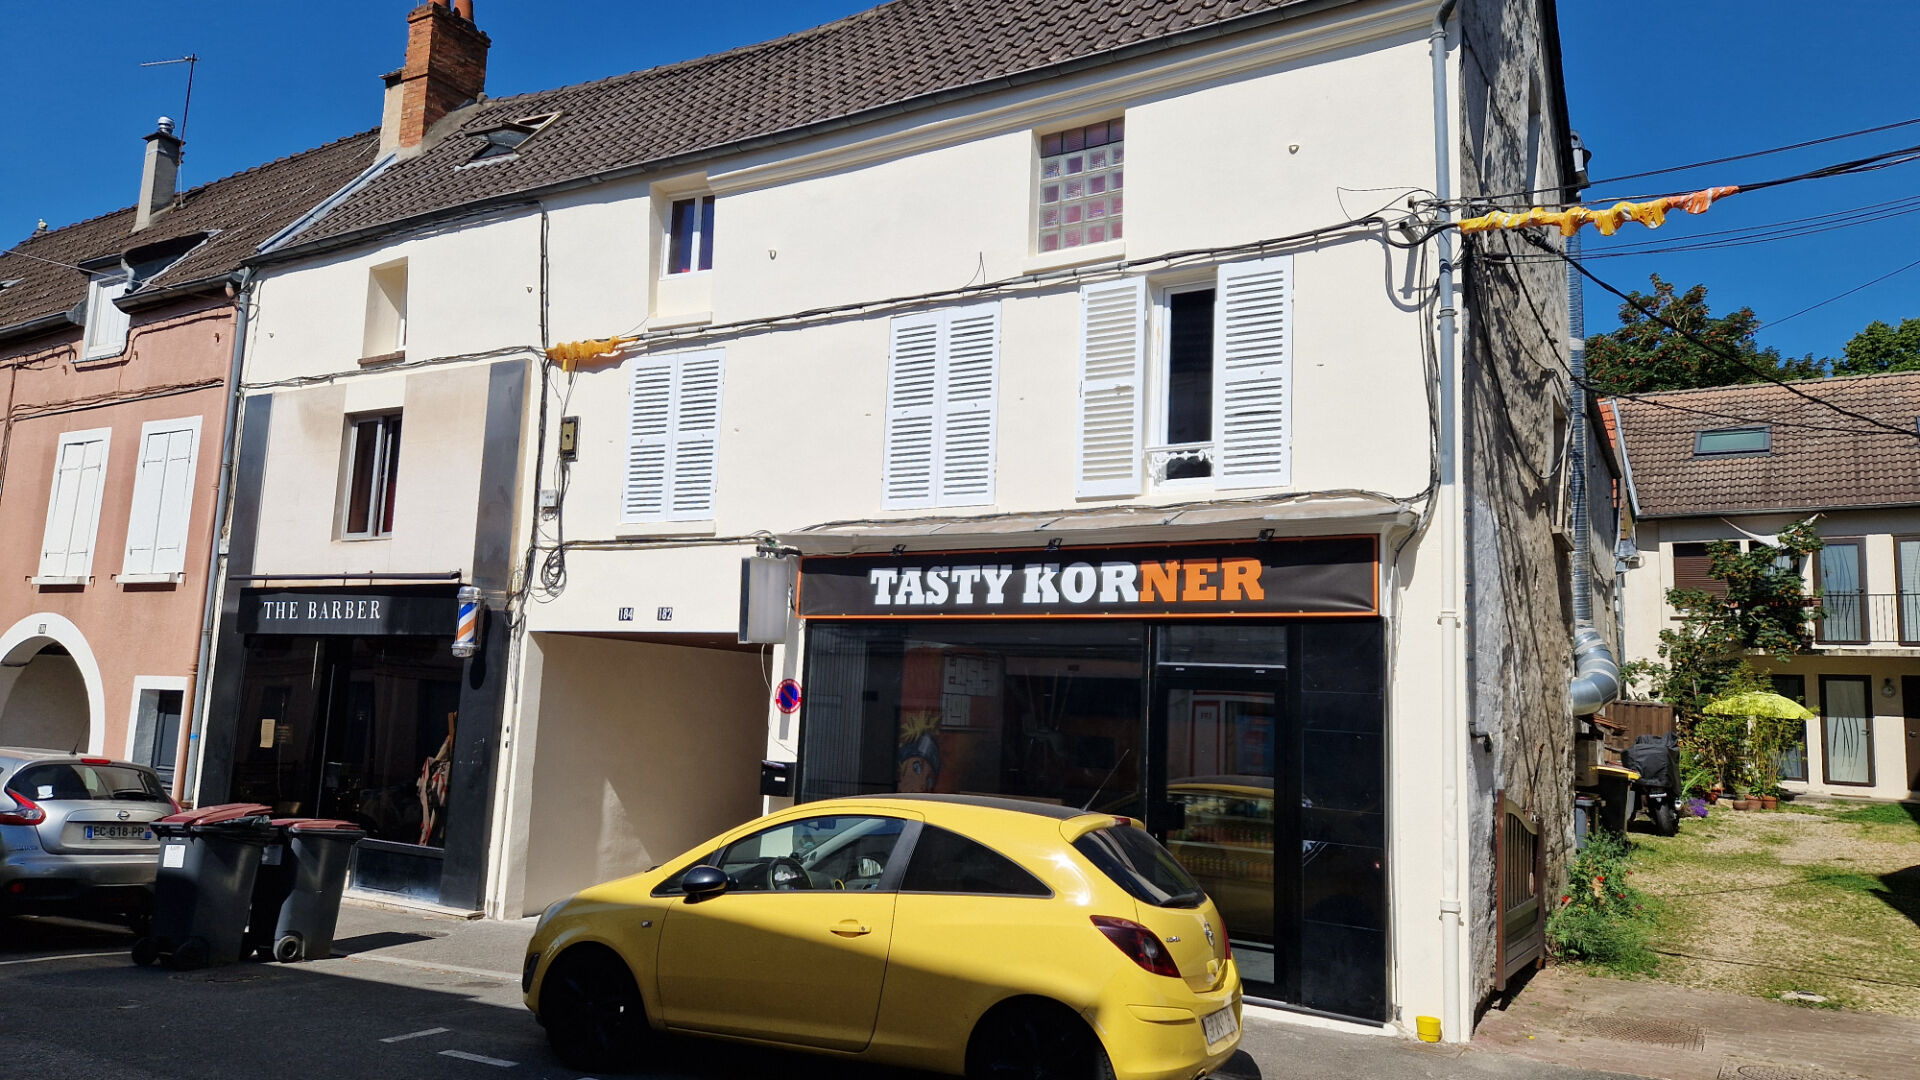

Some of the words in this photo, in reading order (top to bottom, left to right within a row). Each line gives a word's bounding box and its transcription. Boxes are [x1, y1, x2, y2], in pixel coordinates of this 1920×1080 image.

[870, 565, 1012, 605] TASTY
[1022, 558, 1265, 604] KORNER
[264, 601, 299, 619] THE
[307, 600, 381, 619] BARBER
[619, 608, 633, 620] 184
[658, 608, 672, 620] 182
[94, 826, 145, 837] EC-618-PP
